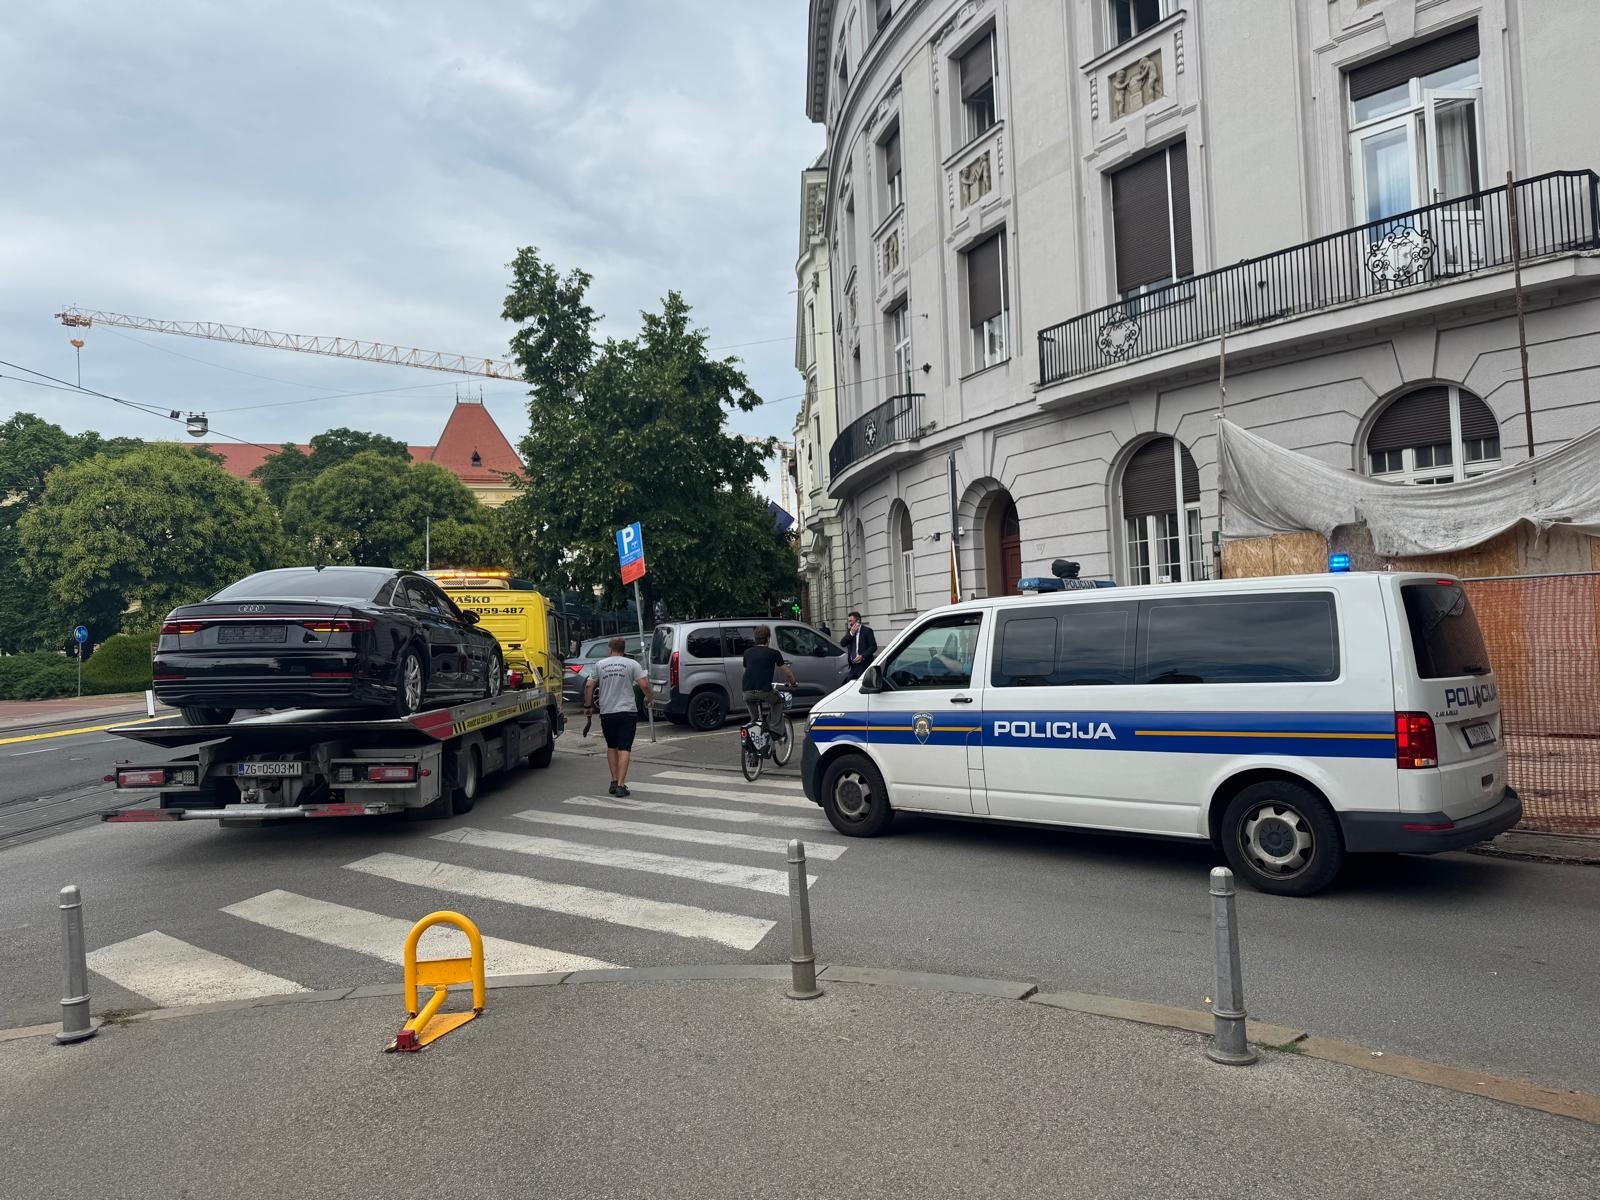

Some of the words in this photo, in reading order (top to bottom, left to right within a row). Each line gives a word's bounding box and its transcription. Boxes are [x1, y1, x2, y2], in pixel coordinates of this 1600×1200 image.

[621, 526, 634, 555] P
[993, 721, 1116, 740] POLICIJA
[245, 764, 257, 775] ZG
